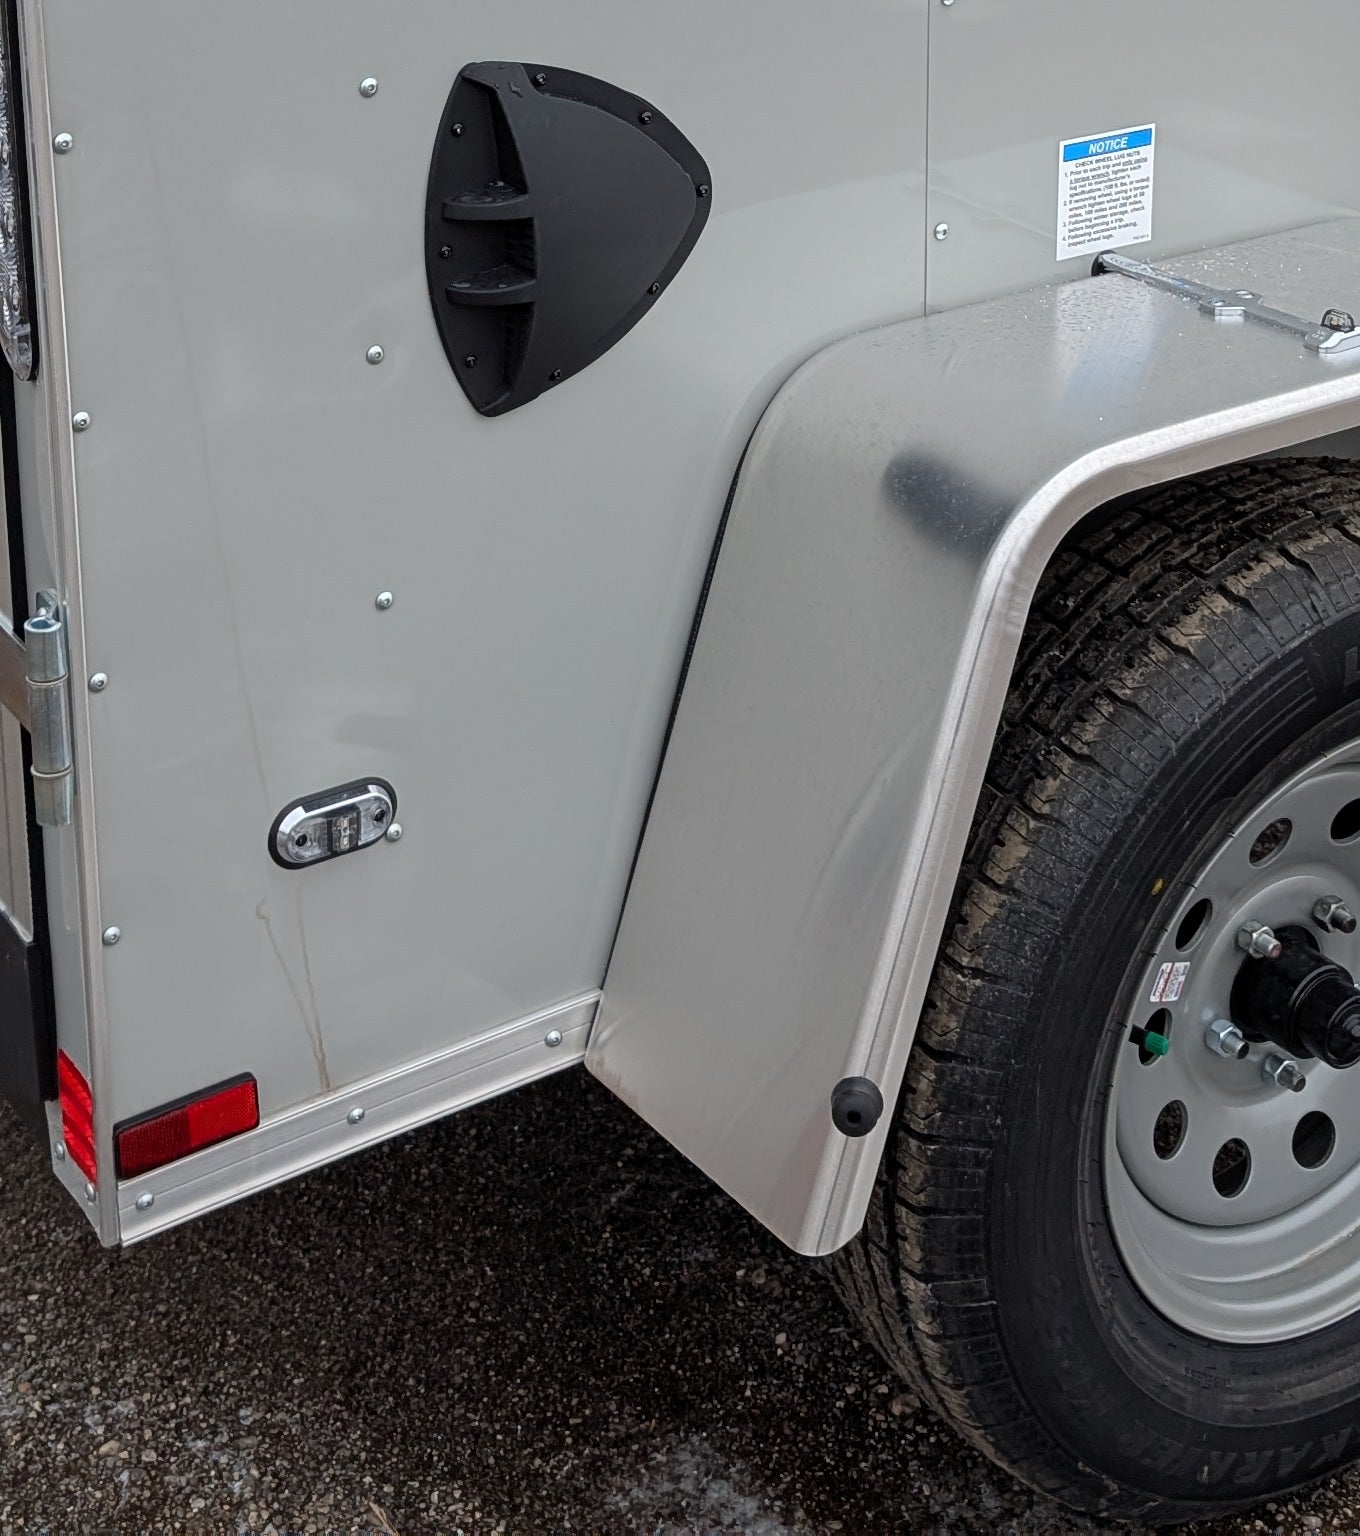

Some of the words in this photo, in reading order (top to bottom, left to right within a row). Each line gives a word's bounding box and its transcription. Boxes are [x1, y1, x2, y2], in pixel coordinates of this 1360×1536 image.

[1089, 137, 1128, 154] NOTICE
[1075, 160, 1093, 168] CHECK
[1095, 156, 1113, 164] WHEEL
[1074, 196, 1096, 204] removing
[1088, 200, 1105, 208] tighten
[1069, 217, 1092, 227] Following
[1085, 220, 1109, 230] beginning
[1068, 231, 1091, 241] Following
[1093, 226, 1117, 234] excessive
